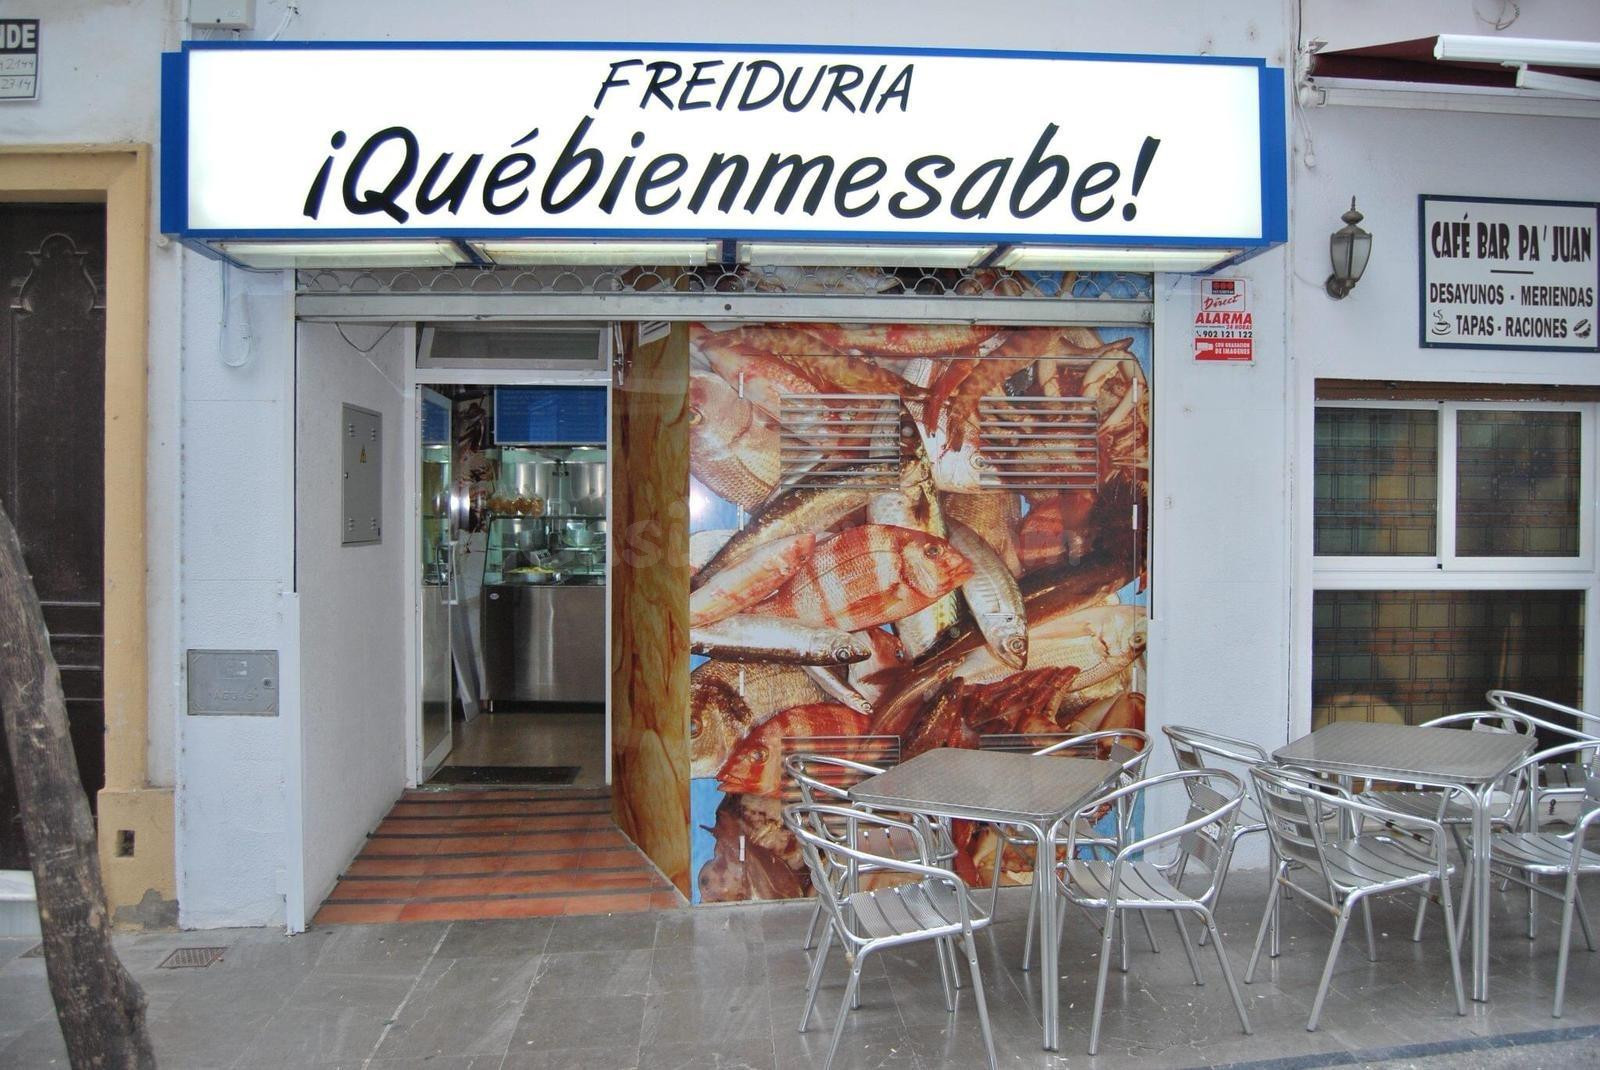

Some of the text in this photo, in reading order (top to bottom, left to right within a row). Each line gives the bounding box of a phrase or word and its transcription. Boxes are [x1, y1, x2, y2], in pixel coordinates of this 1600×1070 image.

[594, 59, 914, 114] FREIDURIA
[303, 115, 1161, 225] ¡Québienmesabe!
[1431, 212, 1470, 259] CAFÉ
[1476, 222, 1510, 261] BAR
[1204, 294, 1242, 310] Direct
[1430, 282, 1593, 308] DESAYUNOS MERIENDAS
[1195, 313, 1252, 324] ALARMA
[1456, 314, 1568, 338] TAPAS RACIONES
[1203, 330, 1218, 338] 902
[1221, 330, 1235, 338] 121
